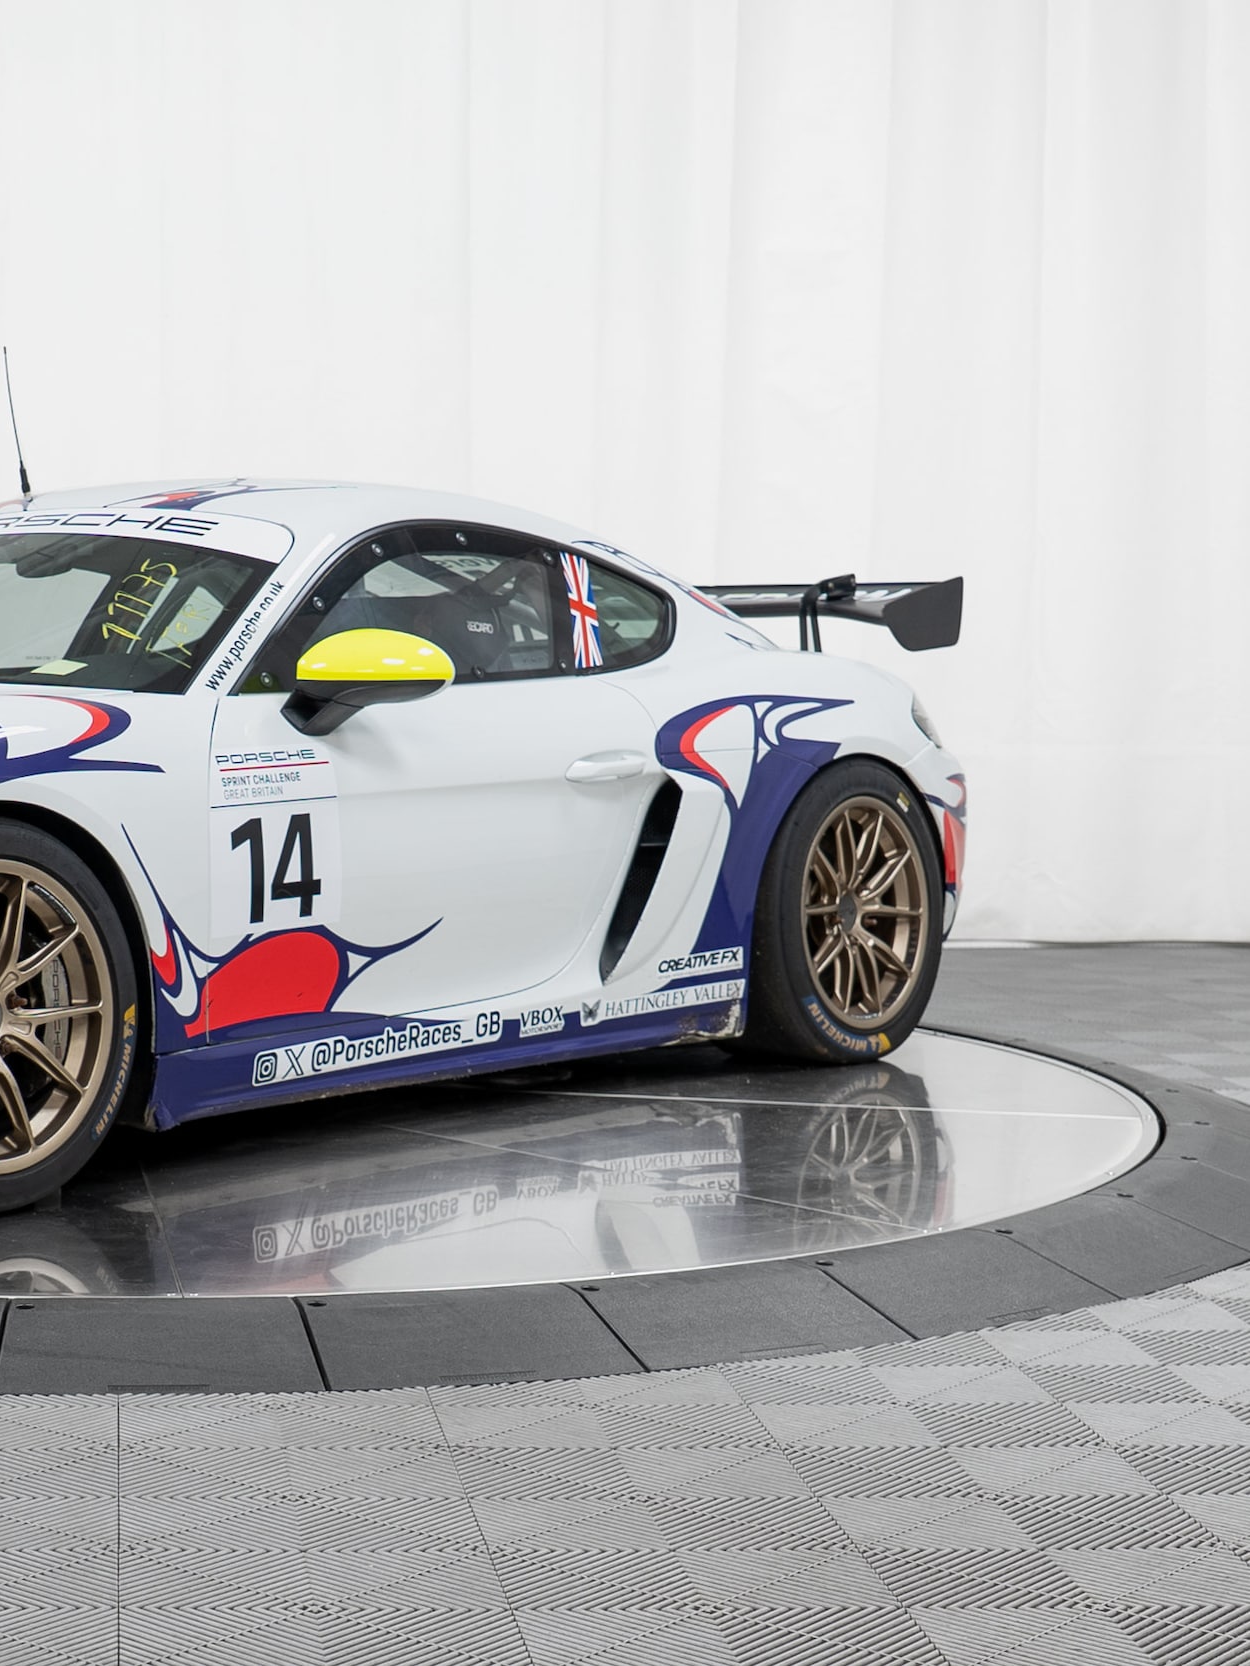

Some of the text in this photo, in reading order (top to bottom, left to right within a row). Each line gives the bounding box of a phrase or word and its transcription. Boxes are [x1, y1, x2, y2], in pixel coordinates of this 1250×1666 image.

[205, 581, 285, 691] www.porschecouk
[215, 749, 315, 764] PORSCHE
[221, 771, 302, 787] SPRINT CHALLENGE
[223, 785, 284, 801] GREAT BRITAIN
[231, 813, 321, 924] 14
[658, 952, 720, 974] CREATIVE
[720, 948, 741, 965] FX
[51, 957, 63, 1060] PORCHE
[520, 1005, 564, 1028] VBOX
[605, 982, 744, 1018] HATTINGLEY VALLEY
[311, 1011, 501, 1072] @PorscheRaces_GB
[808, 1002, 868, 1052] MICHELIN
[95, 1043, 132, 1136] MICHELIN
